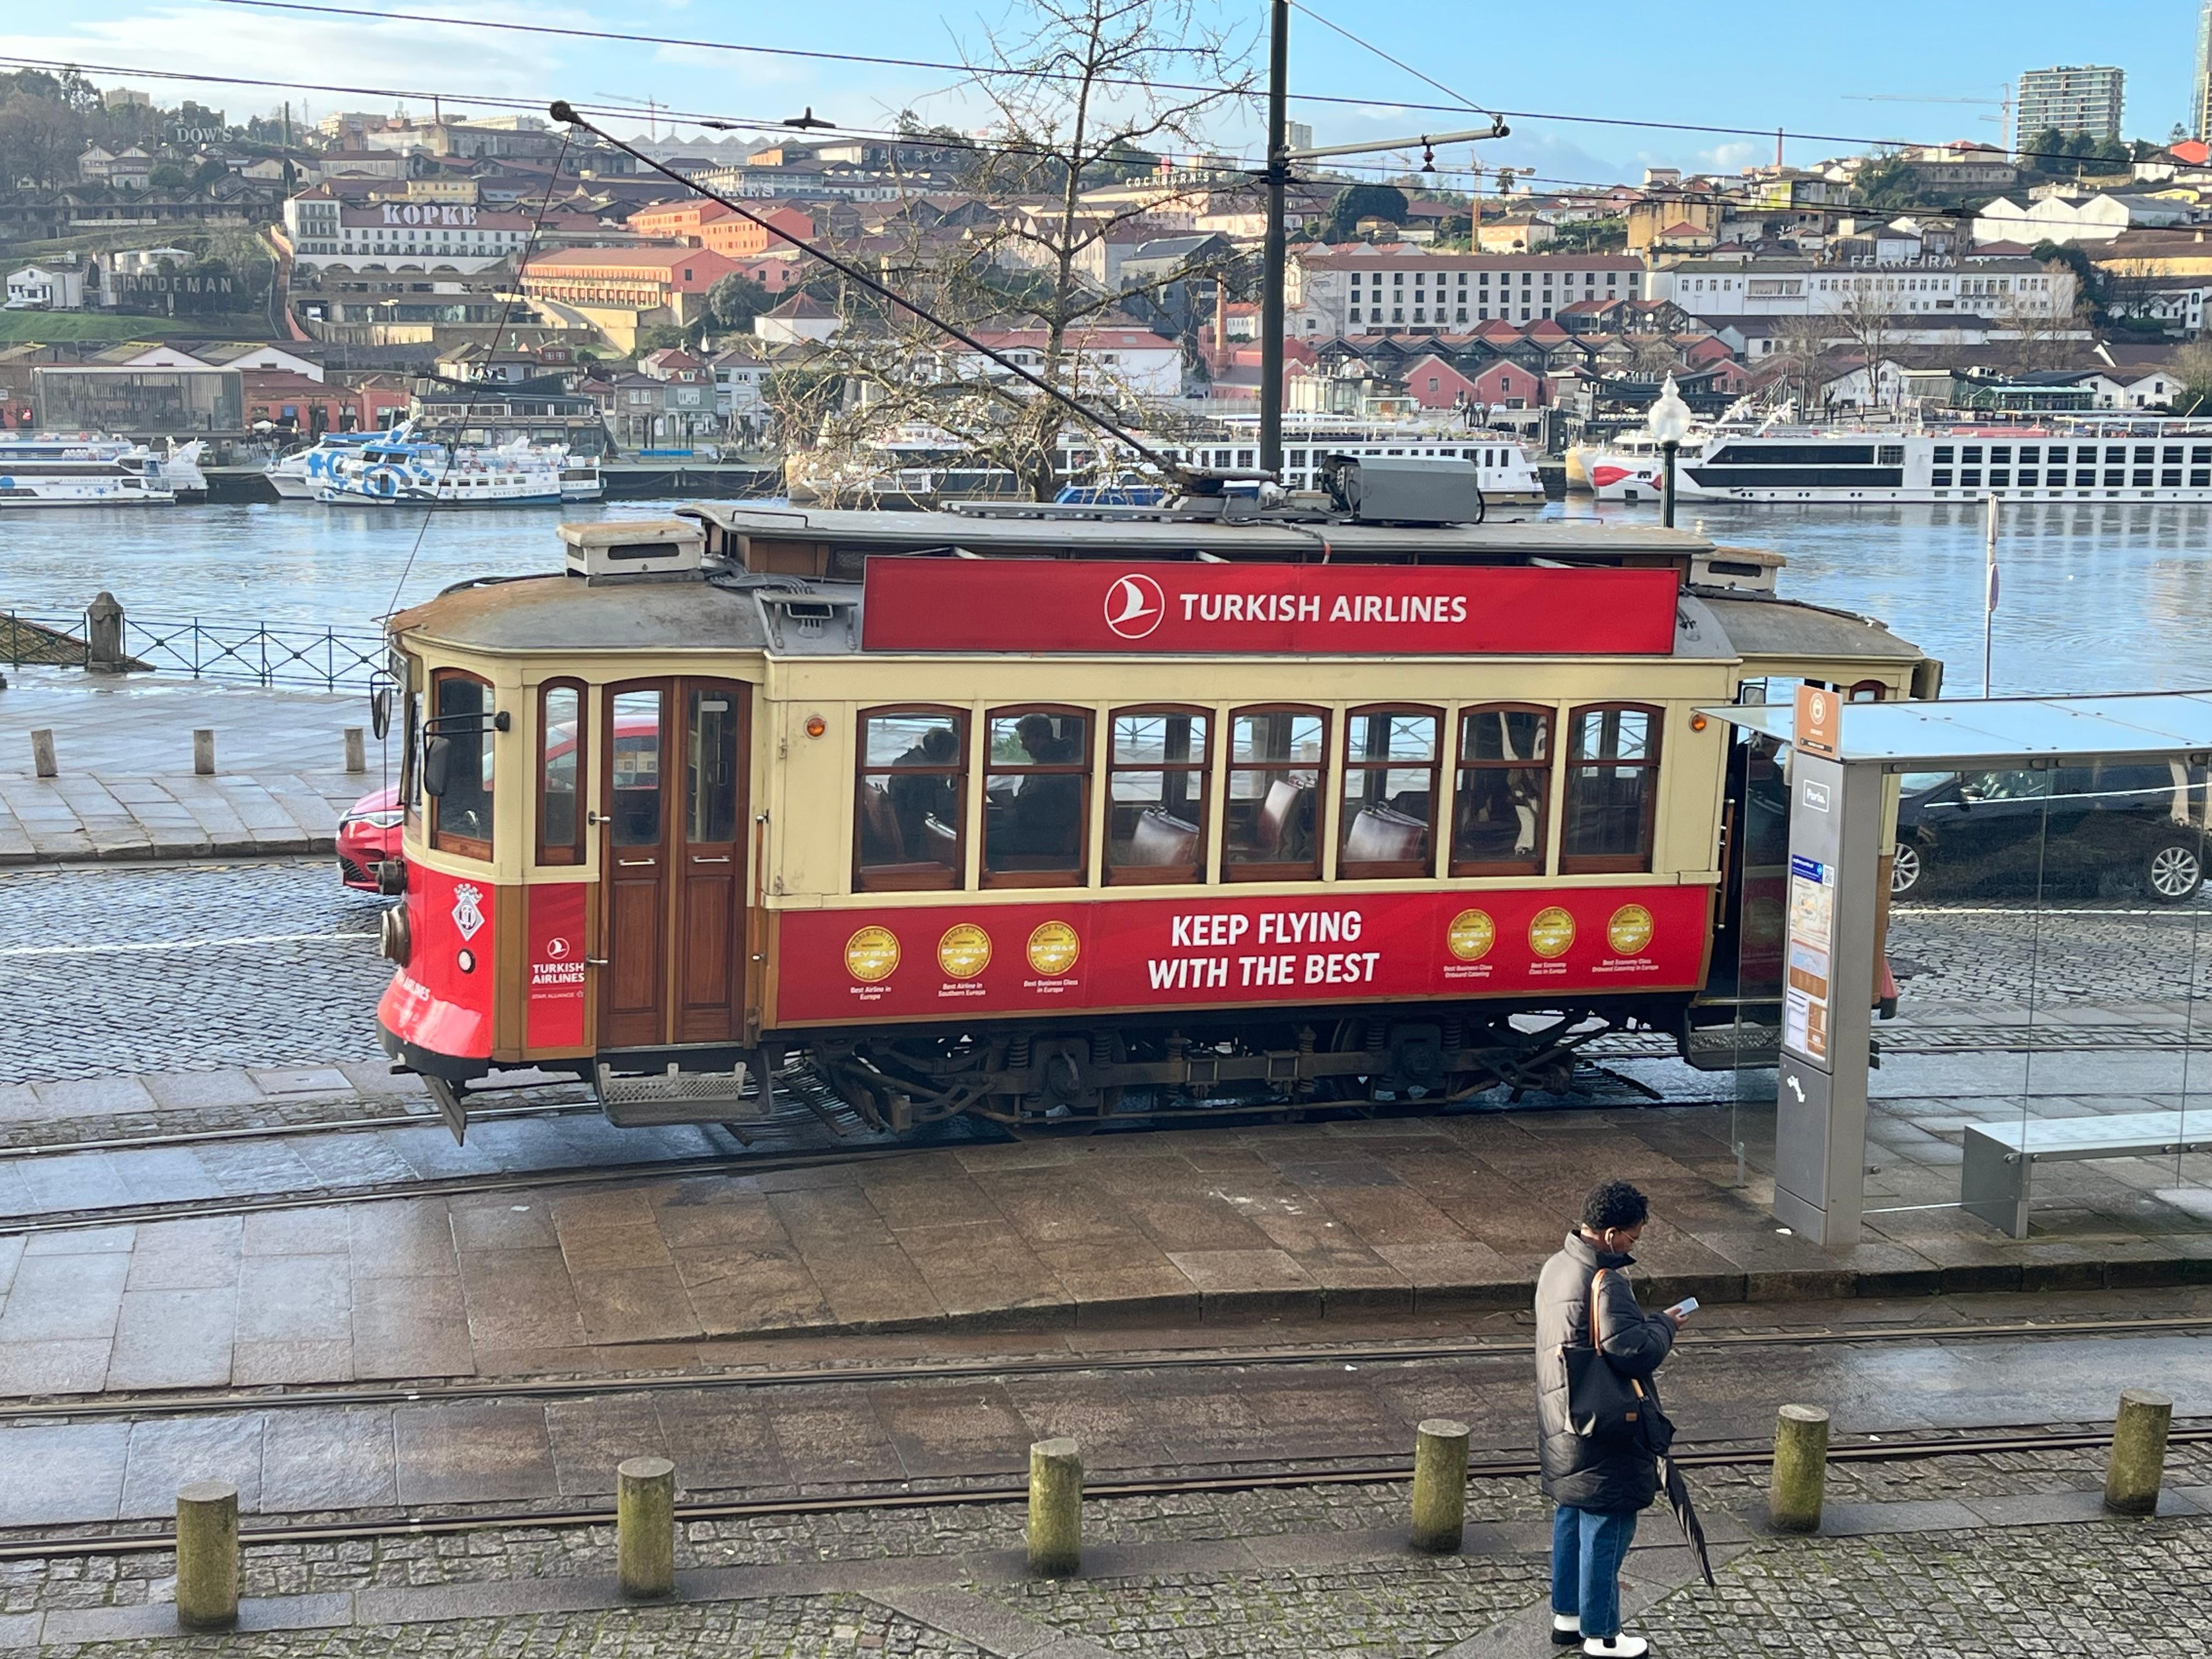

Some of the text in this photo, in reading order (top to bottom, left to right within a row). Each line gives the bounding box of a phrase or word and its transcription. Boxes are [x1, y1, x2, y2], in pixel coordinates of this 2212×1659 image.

[176, 126, 233, 142] DOW'S
[863, 149, 959, 163] BARROS
[1126, 171, 1209, 188] COCKBURN'S
[382, 204, 476, 225] KOPKE
[1850, 254, 1955, 269] FERREIRA
[1180, 594, 1467, 623] TURKISH AIRLINES
[1172, 911, 1362, 947] KEEP FLYING
[532, 962, 584, 974] TURKISH
[1148, 952, 1381, 990] WITH THE BEST
[532, 973, 585, 985] AIRLINES
